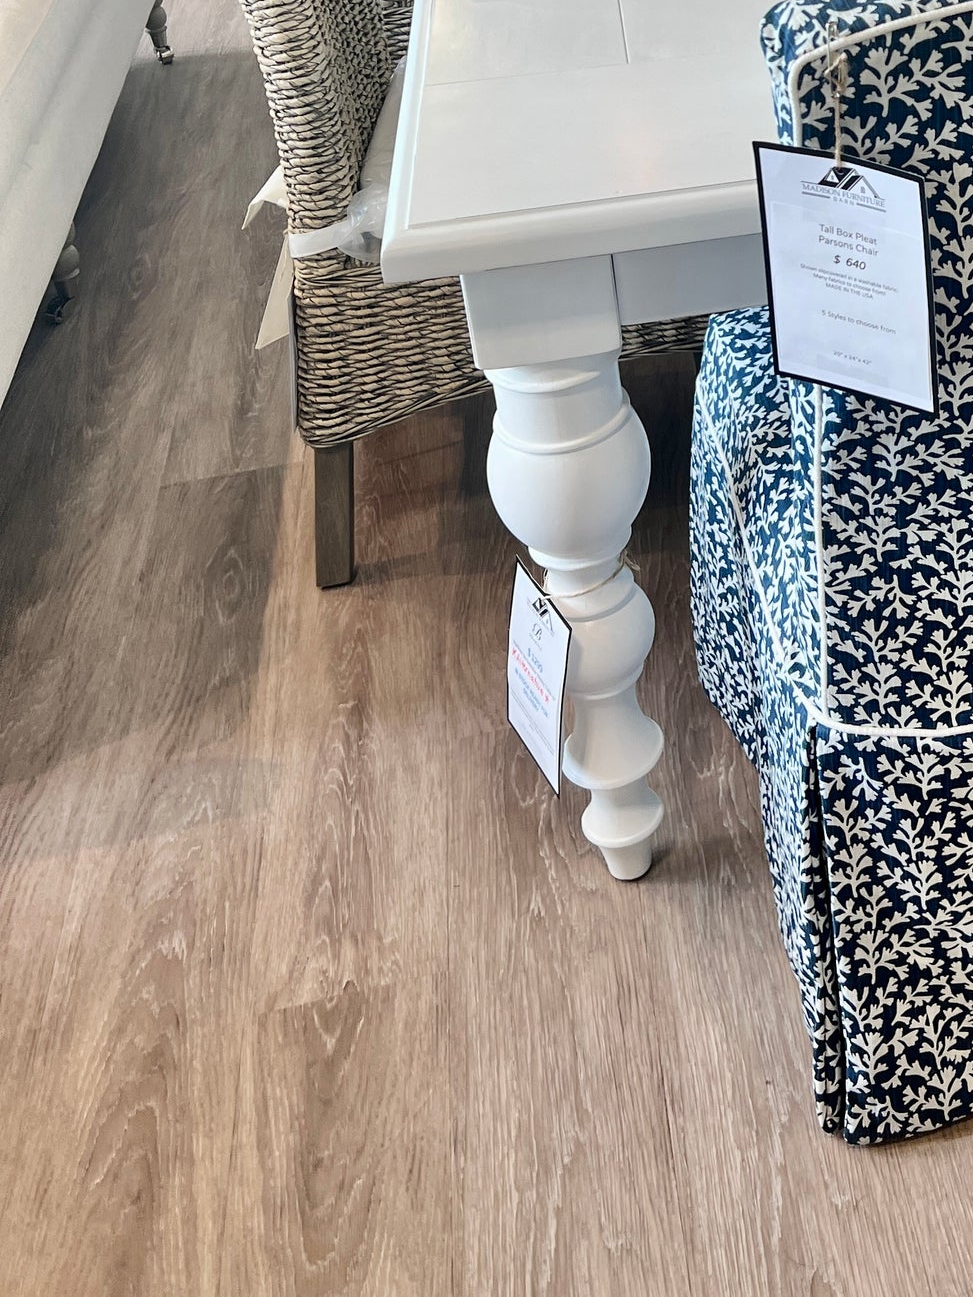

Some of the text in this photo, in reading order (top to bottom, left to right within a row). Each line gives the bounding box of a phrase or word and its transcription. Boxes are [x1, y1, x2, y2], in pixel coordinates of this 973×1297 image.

[802, 183, 886, 208] MADISON FURNITURE
[833, 196, 855, 206] BARN
[819, 223, 877, 245] Tall Box Pleat
[818, 235, 879, 257] Parsons Chair
[833, 254, 867, 271] $ 640
[861, 291, 874, 300] USA
[827, 310, 847, 321] Styles
[855, 319, 879, 330] choose
[880, 325, 897, 335] from
